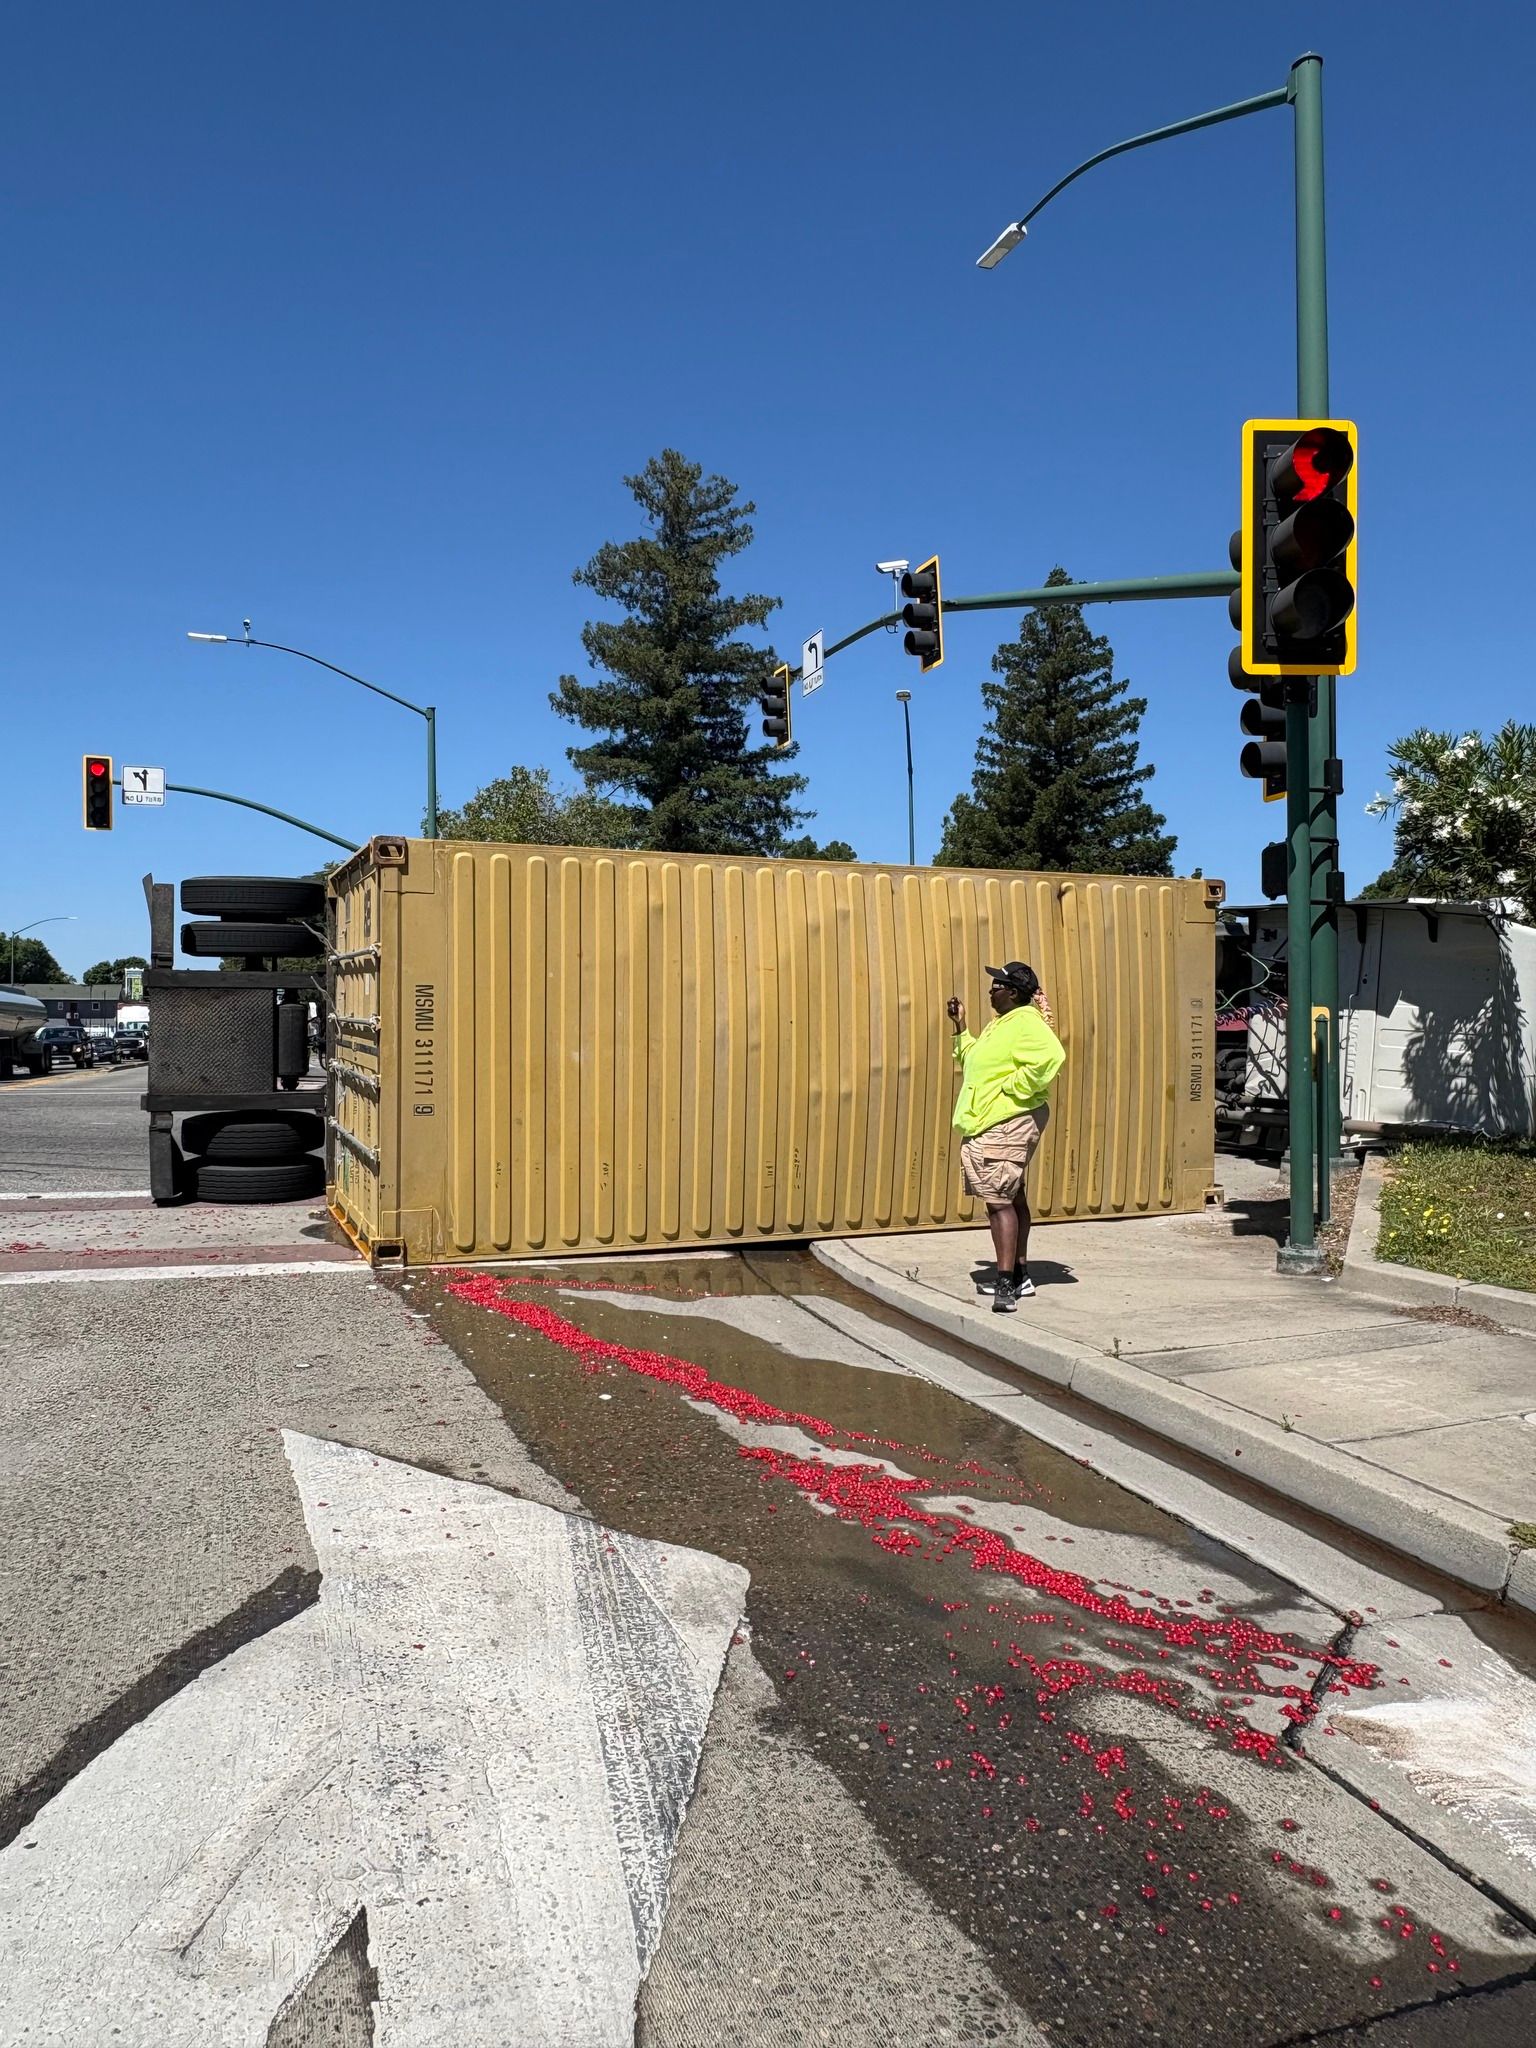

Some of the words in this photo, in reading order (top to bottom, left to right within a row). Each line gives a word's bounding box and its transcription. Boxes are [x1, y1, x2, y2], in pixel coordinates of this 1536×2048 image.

[136, 794, 143, 803] U
[414, 984, 434, 1032] MSMU
[1191, 1015, 1203, 1060] 311171
[414, 1039, 434, 1095] 311171
[1190, 1064, 1203, 1102] MSMU
[414, 1105, 434, 1116] 9
